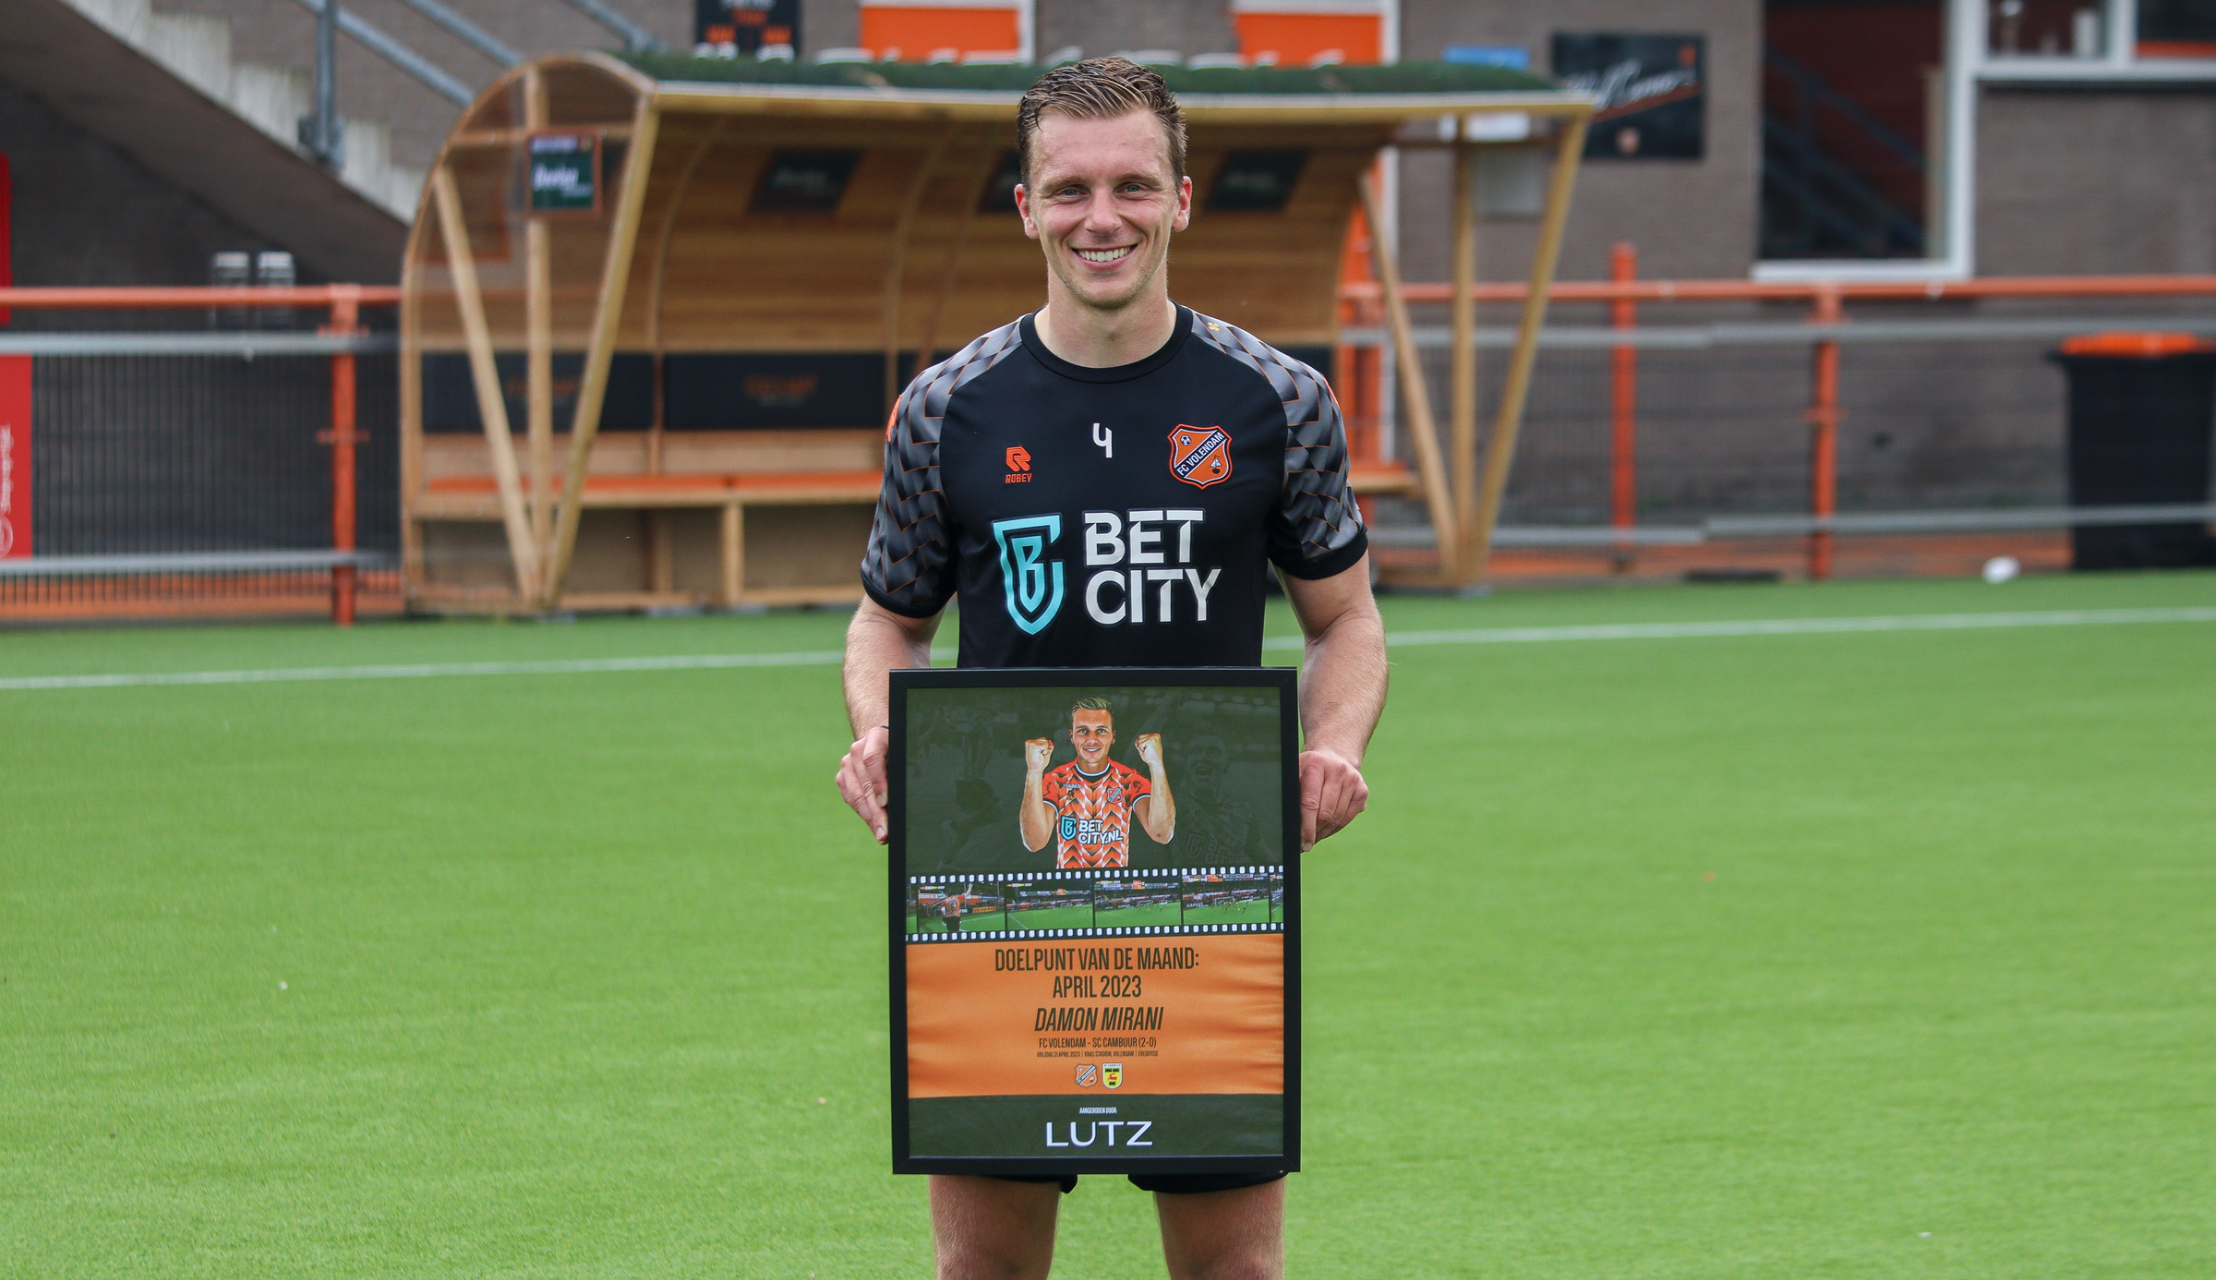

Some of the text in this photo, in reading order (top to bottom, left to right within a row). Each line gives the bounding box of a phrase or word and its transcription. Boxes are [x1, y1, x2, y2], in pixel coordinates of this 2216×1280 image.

[1093, 422, 1112, 458] 4
[1176, 431, 1225, 476] FC VOLENDAM
[1005, 473, 1032, 484] ROBEY
[1084, 510, 1203, 565] BET
[1085, 568, 1221, 624] CITY
[1078, 829, 1123, 845] CITY.NL
[1079, 820, 1103, 832] BET
[995, 948, 1199, 971] DOELPUNT VAN DE MAAND:
[1053, 975, 1142, 999] APRIL 2023
[1034, 1007, 1164, 1032] DAMON MIRANI
[1039, 1038, 1047, 1048] FC
[1048, 1038, 1087, 1048] VOLENDAM
[1093, 1038, 1102, 1048] SC
[1103, 1038, 1138, 1048] CAMBUUR
[1139, 1037, 1157, 1048] (2-0)
[1046, 1120, 1153, 1147] LUTZ
